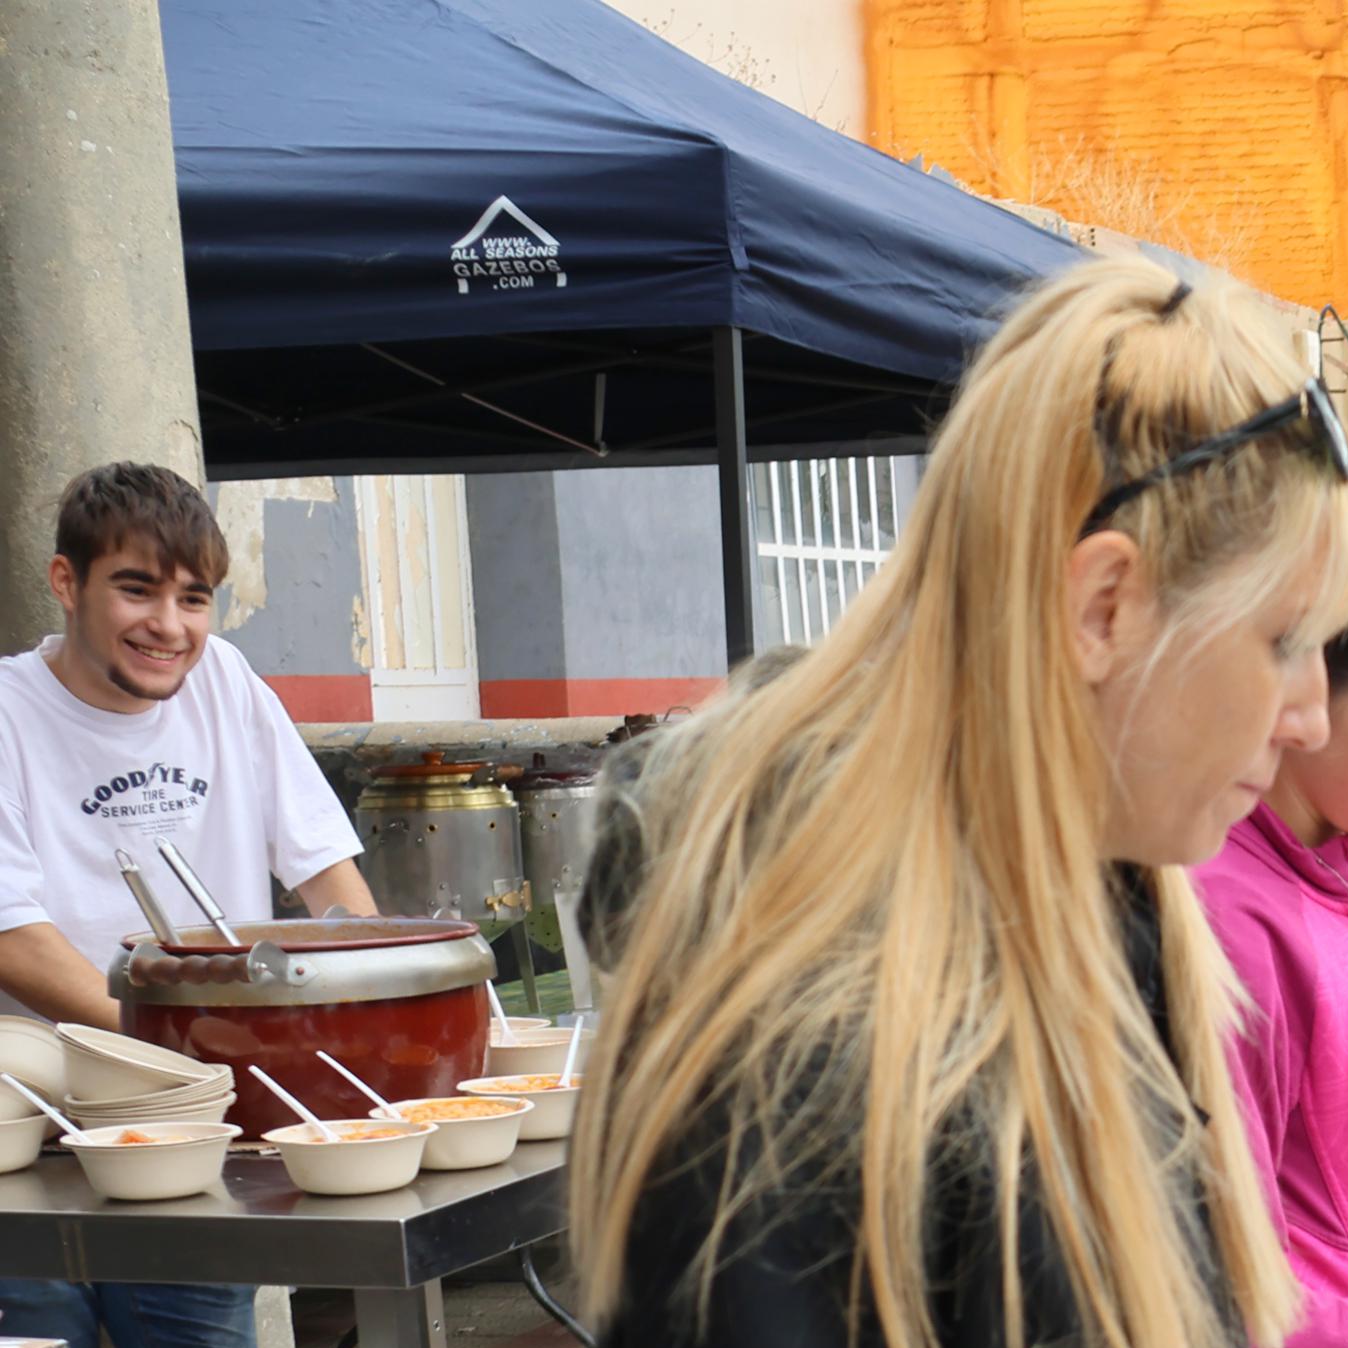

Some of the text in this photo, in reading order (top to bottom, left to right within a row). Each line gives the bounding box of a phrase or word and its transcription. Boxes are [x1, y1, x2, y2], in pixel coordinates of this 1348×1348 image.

[482, 237, 531, 249] WWW.
[451, 246, 558, 260] ALL SEASONS
[453, 259, 561, 277] GAZEBOS
[493, 275, 534, 290] .COM
[142, 788, 165, 802] TIRE
[101, 803, 156, 818] SERVICE
